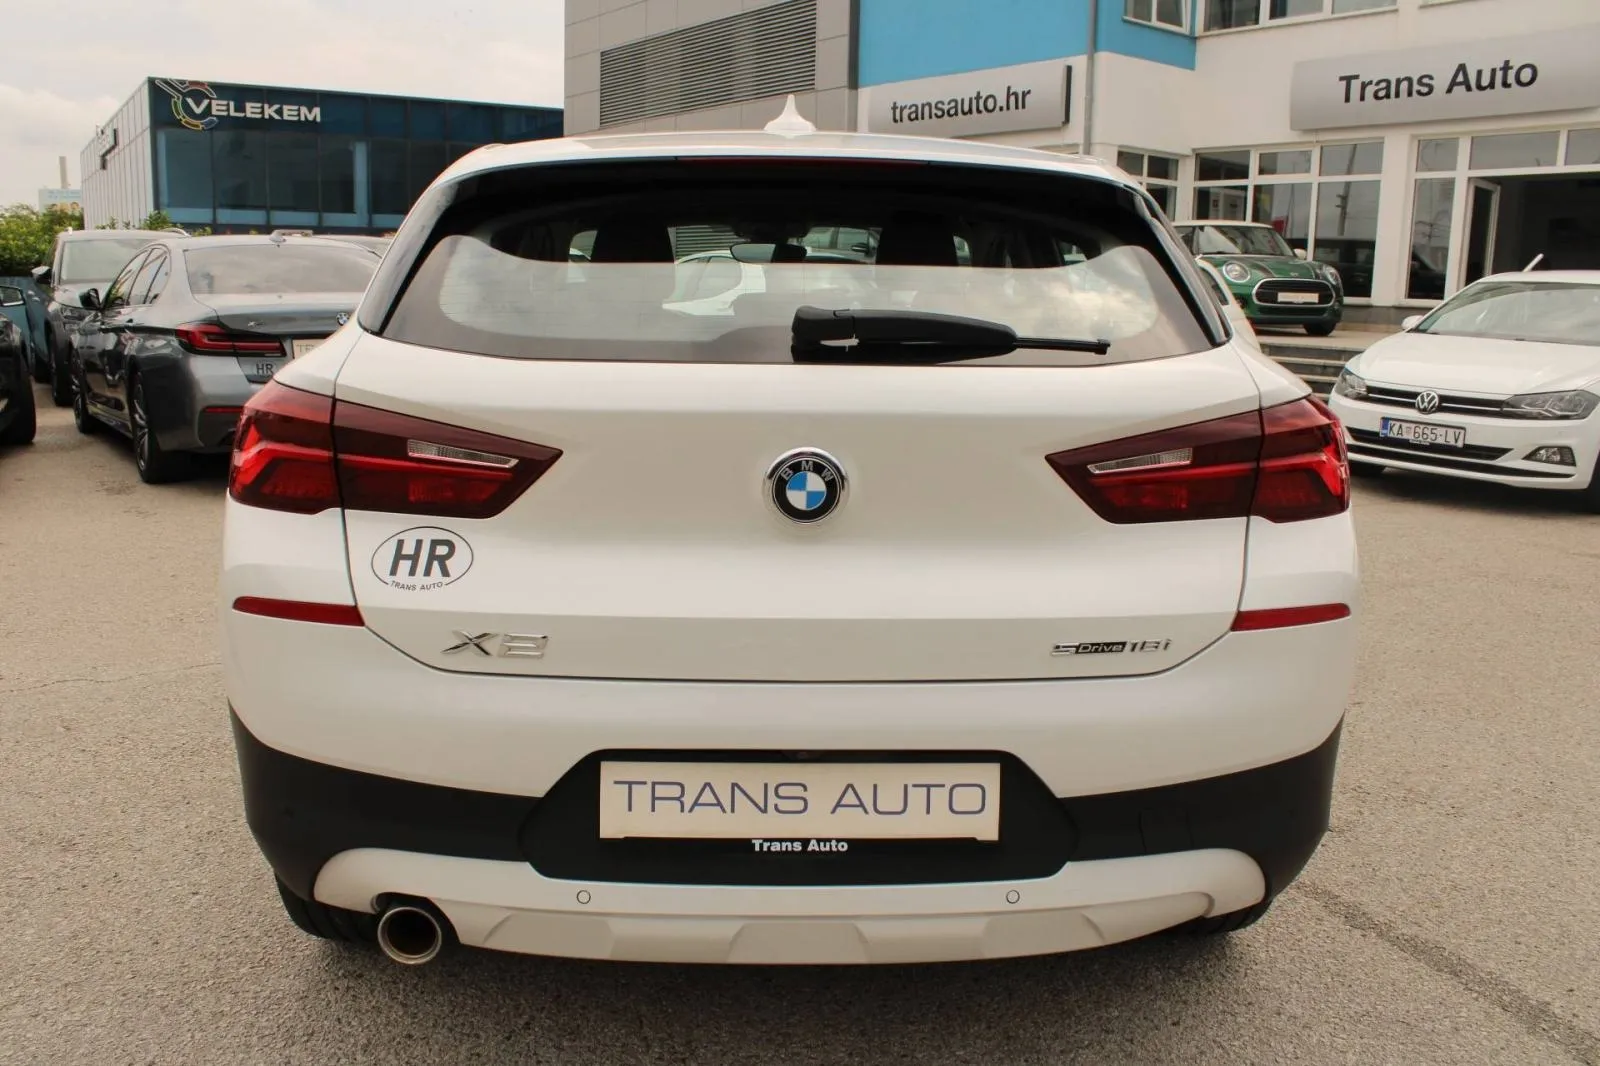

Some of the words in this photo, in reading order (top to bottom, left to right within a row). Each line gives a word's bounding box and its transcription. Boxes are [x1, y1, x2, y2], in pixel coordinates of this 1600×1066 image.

[1338, 73, 1435, 104] Trans
[1445, 59, 1539, 95] Auto
[185, 97, 322, 123] VELEKEM
[890, 85, 1032, 124] transauto.hr
[255, 362, 274, 376] HR
[1388, 422, 1404, 437] KA
[780, 460, 835, 482] BMW
[388, 538, 456, 578] HR
[390, 580, 417, 592] TRANS
[419, 581, 444, 592] AUTO
[440, 630, 549, 660] X2
[613, 780, 809, 815] TRANS
[830, 783, 987, 816] AUTO
[752, 839, 802, 852] Trans
[807, 839, 849, 852] Auto
